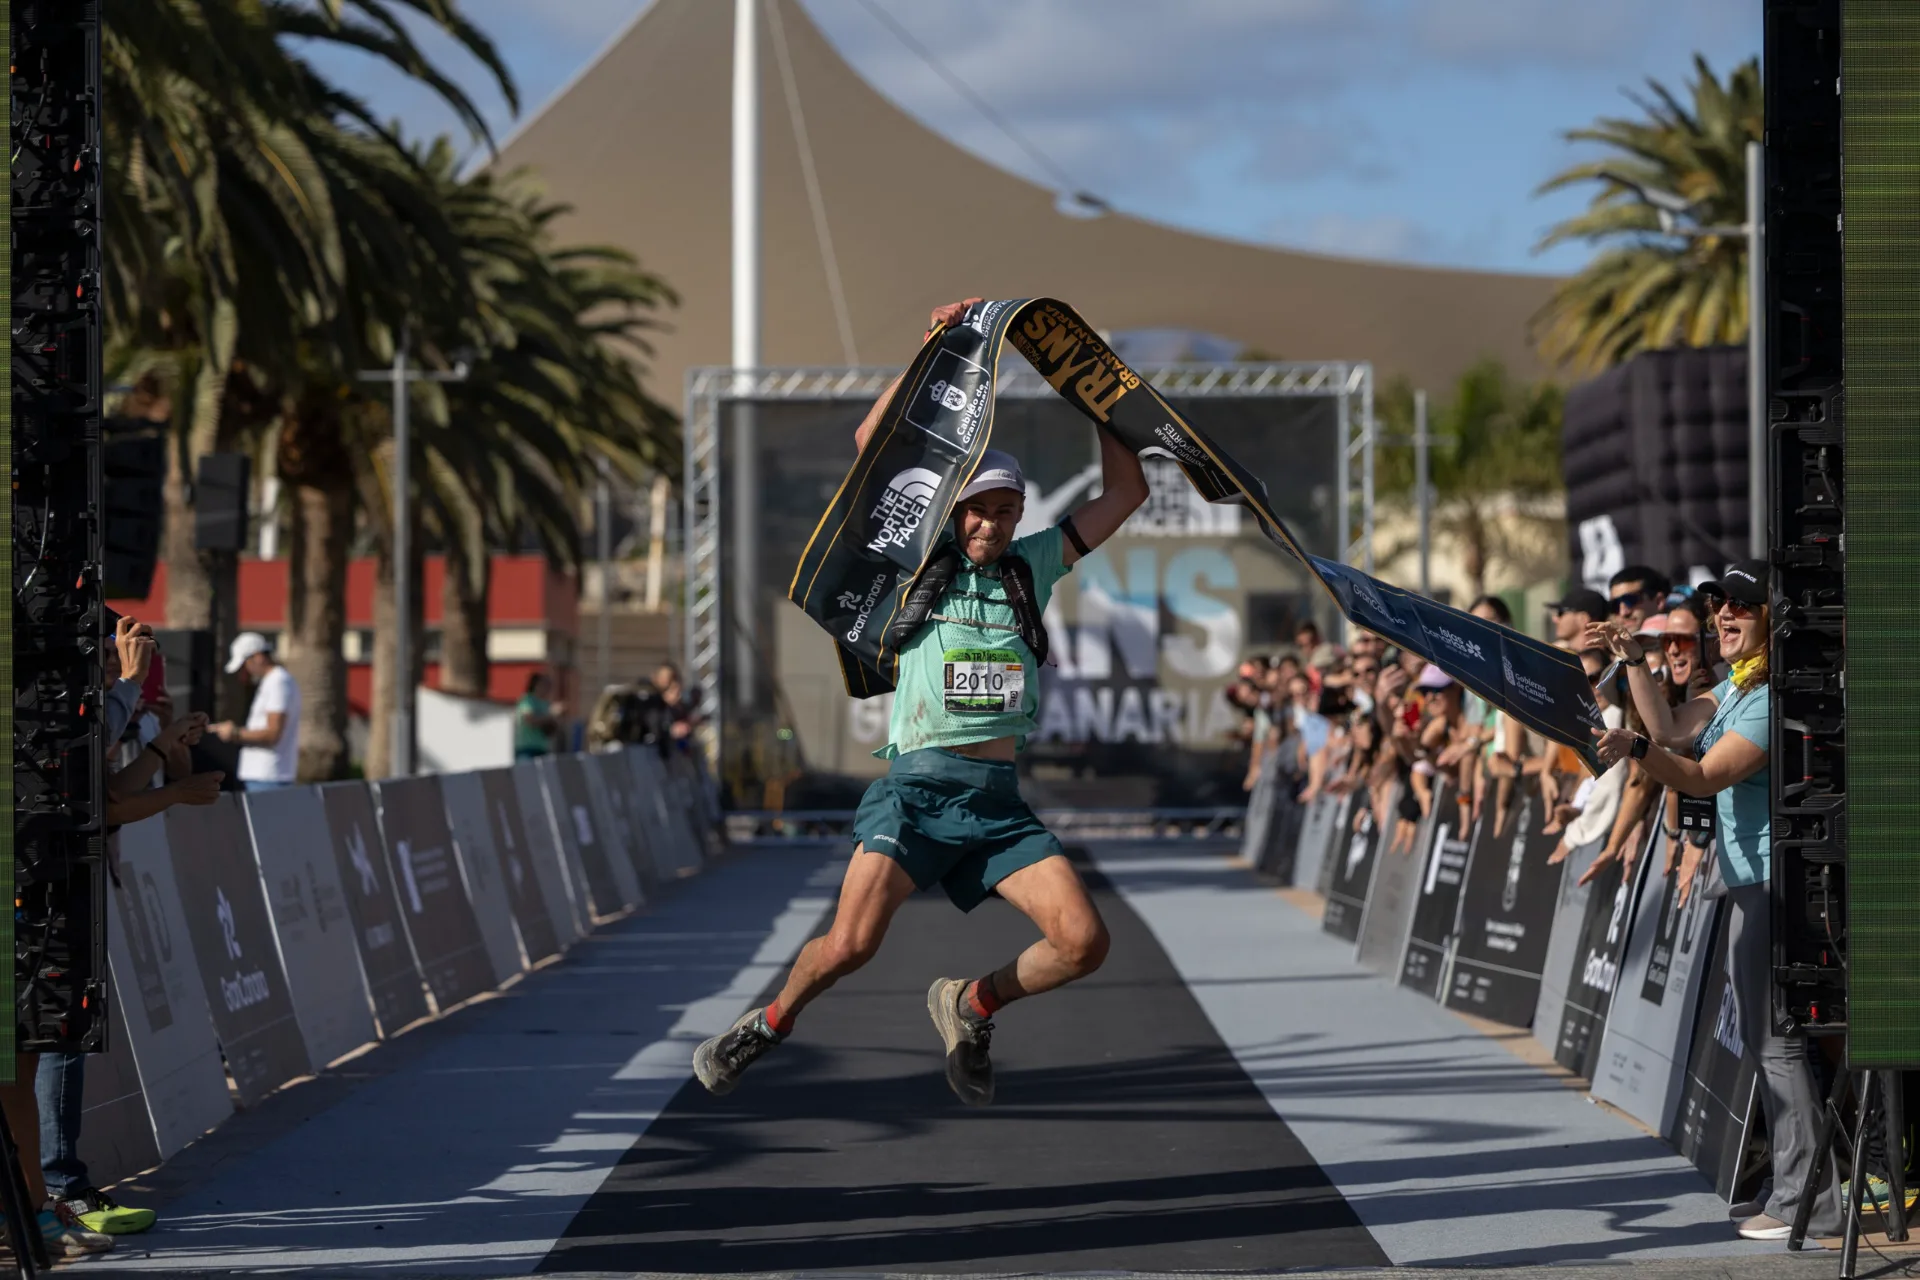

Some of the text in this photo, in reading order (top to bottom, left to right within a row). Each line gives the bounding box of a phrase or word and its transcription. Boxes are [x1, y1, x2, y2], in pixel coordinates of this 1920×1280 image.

[1023, 310, 1127, 423] TRANS
[1045, 304, 1140, 390] GRAN CANARIA
[957, 384, 985, 436] Cabildo de
[962, 380, 990, 444] Gran Canaria
[1154, 427, 1178, 451] INSULAR
[1162, 423, 1202, 458] DEPORTES
[867, 496, 912, 553] NORTH
[870, 488, 899, 521] THE
[892, 503, 927, 548] FACE
[847, 573, 887, 642] GranCanaria
[971, 650, 997, 661] TRANS
[956, 672, 1003, 690] 2010
[1515, 673, 1547, 693] Gobierno
[1516, 681, 1525, 690] de
[1524, 685, 1555, 704] Canarias
